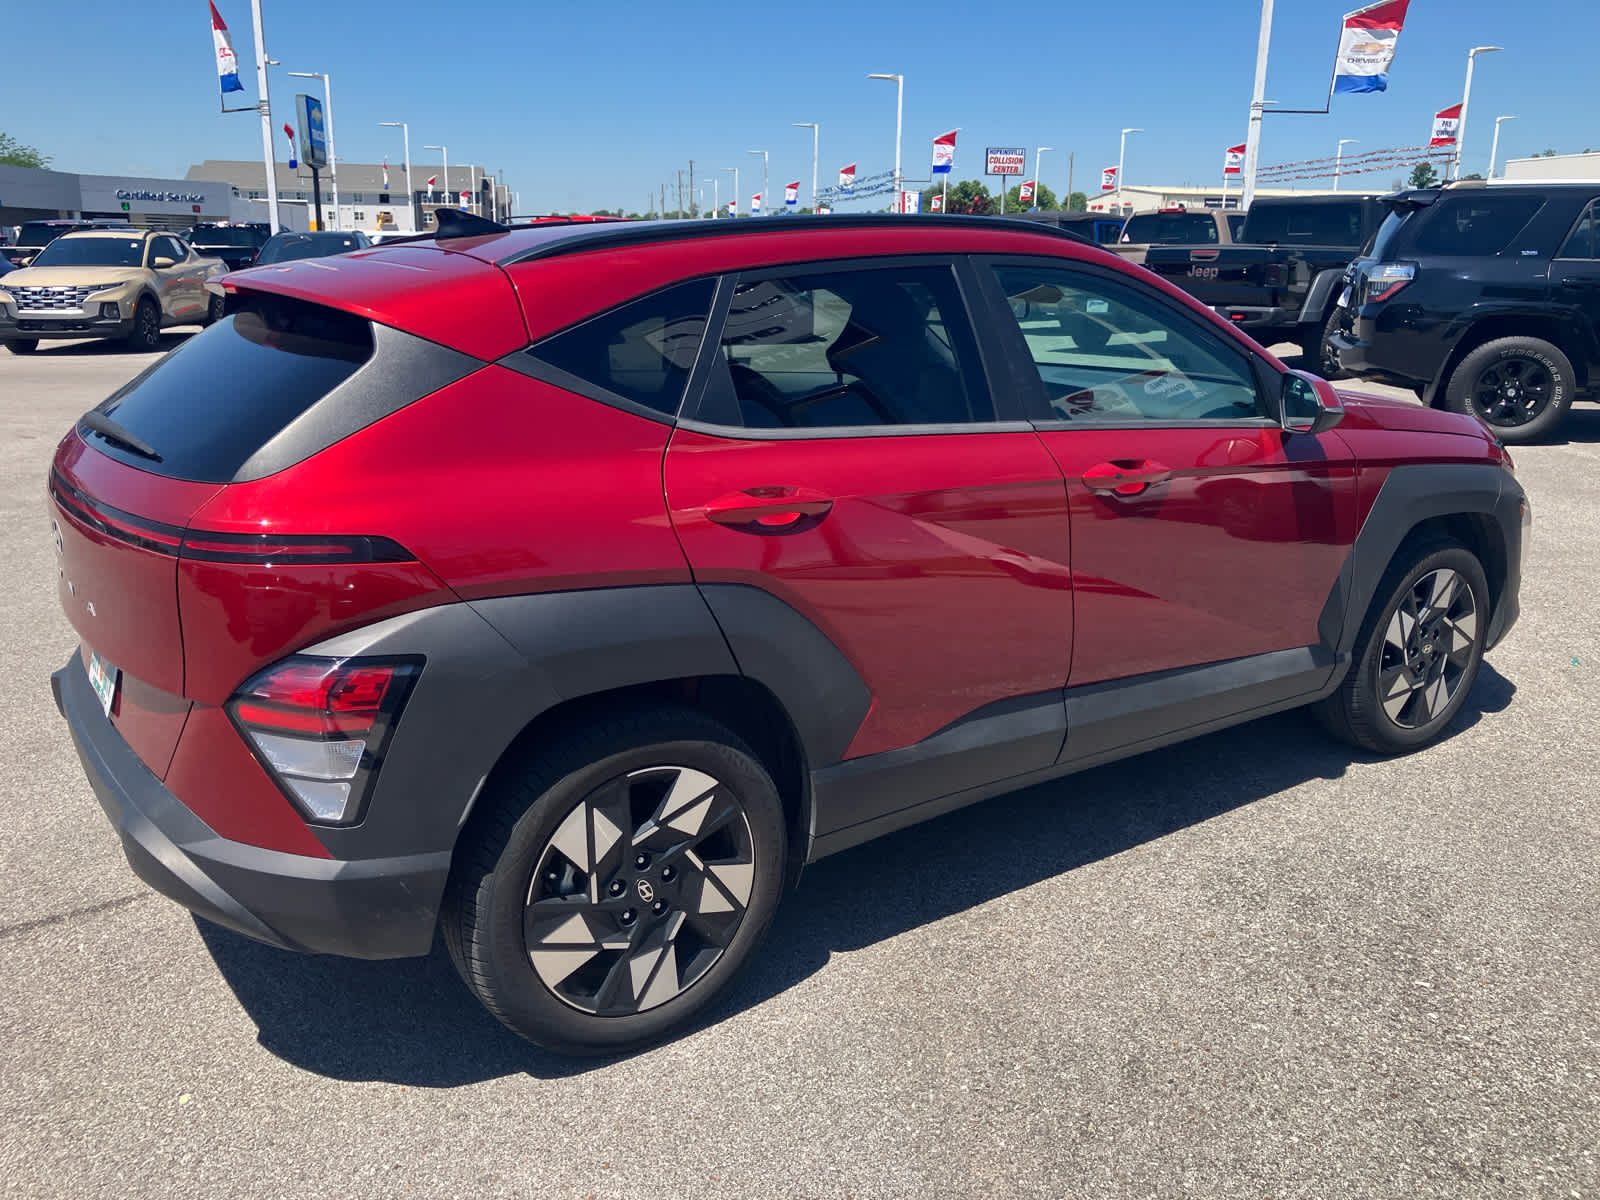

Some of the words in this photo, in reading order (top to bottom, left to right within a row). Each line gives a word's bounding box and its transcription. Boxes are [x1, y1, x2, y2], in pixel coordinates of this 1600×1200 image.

[989, 156, 1024, 165] COLLISION
[992, 165, 1019, 174] CENTER
[116, 189, 163, 201] Certified
[167, 192, 204, 204] Service
[1186, 264, 1219, 280] Jeep
